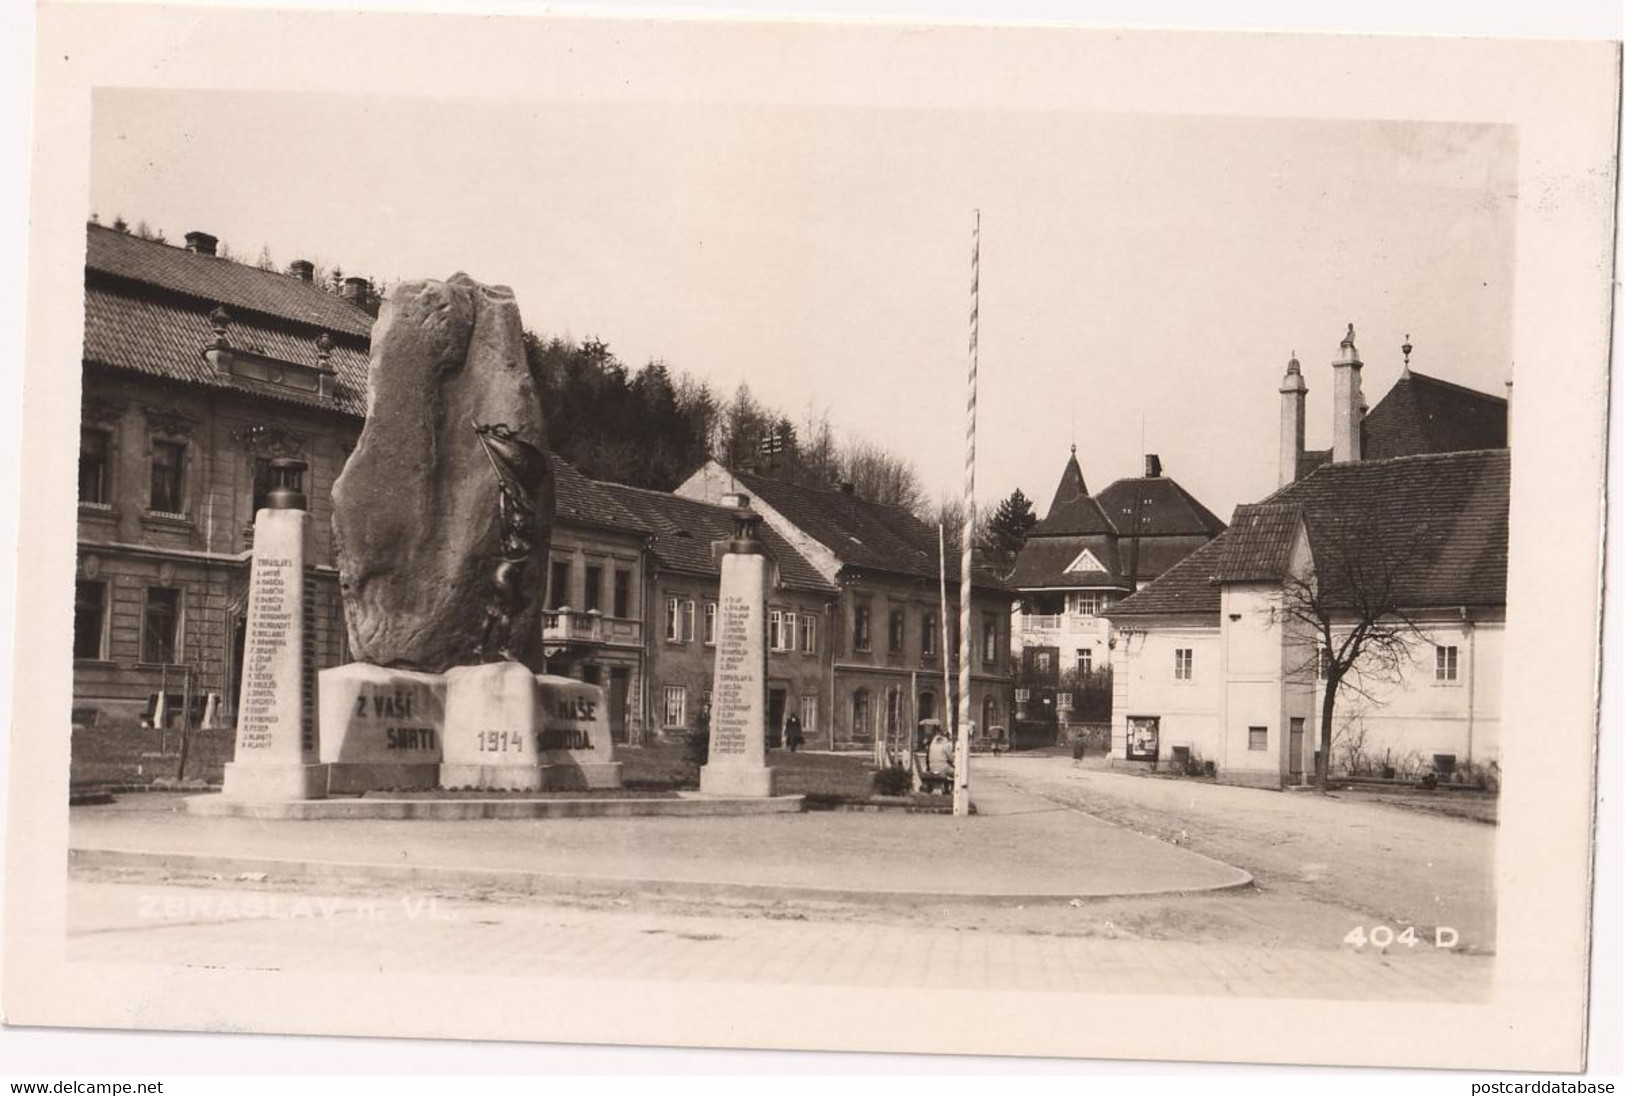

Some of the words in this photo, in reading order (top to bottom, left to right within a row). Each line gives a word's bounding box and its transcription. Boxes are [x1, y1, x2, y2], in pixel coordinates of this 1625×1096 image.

[356, 696, 367, 718] Z
[373, 691, 412, 719] VAŠÍ
[387, 727, 435, 749] SMRTI
[477, 730, 523, 752] 1914
